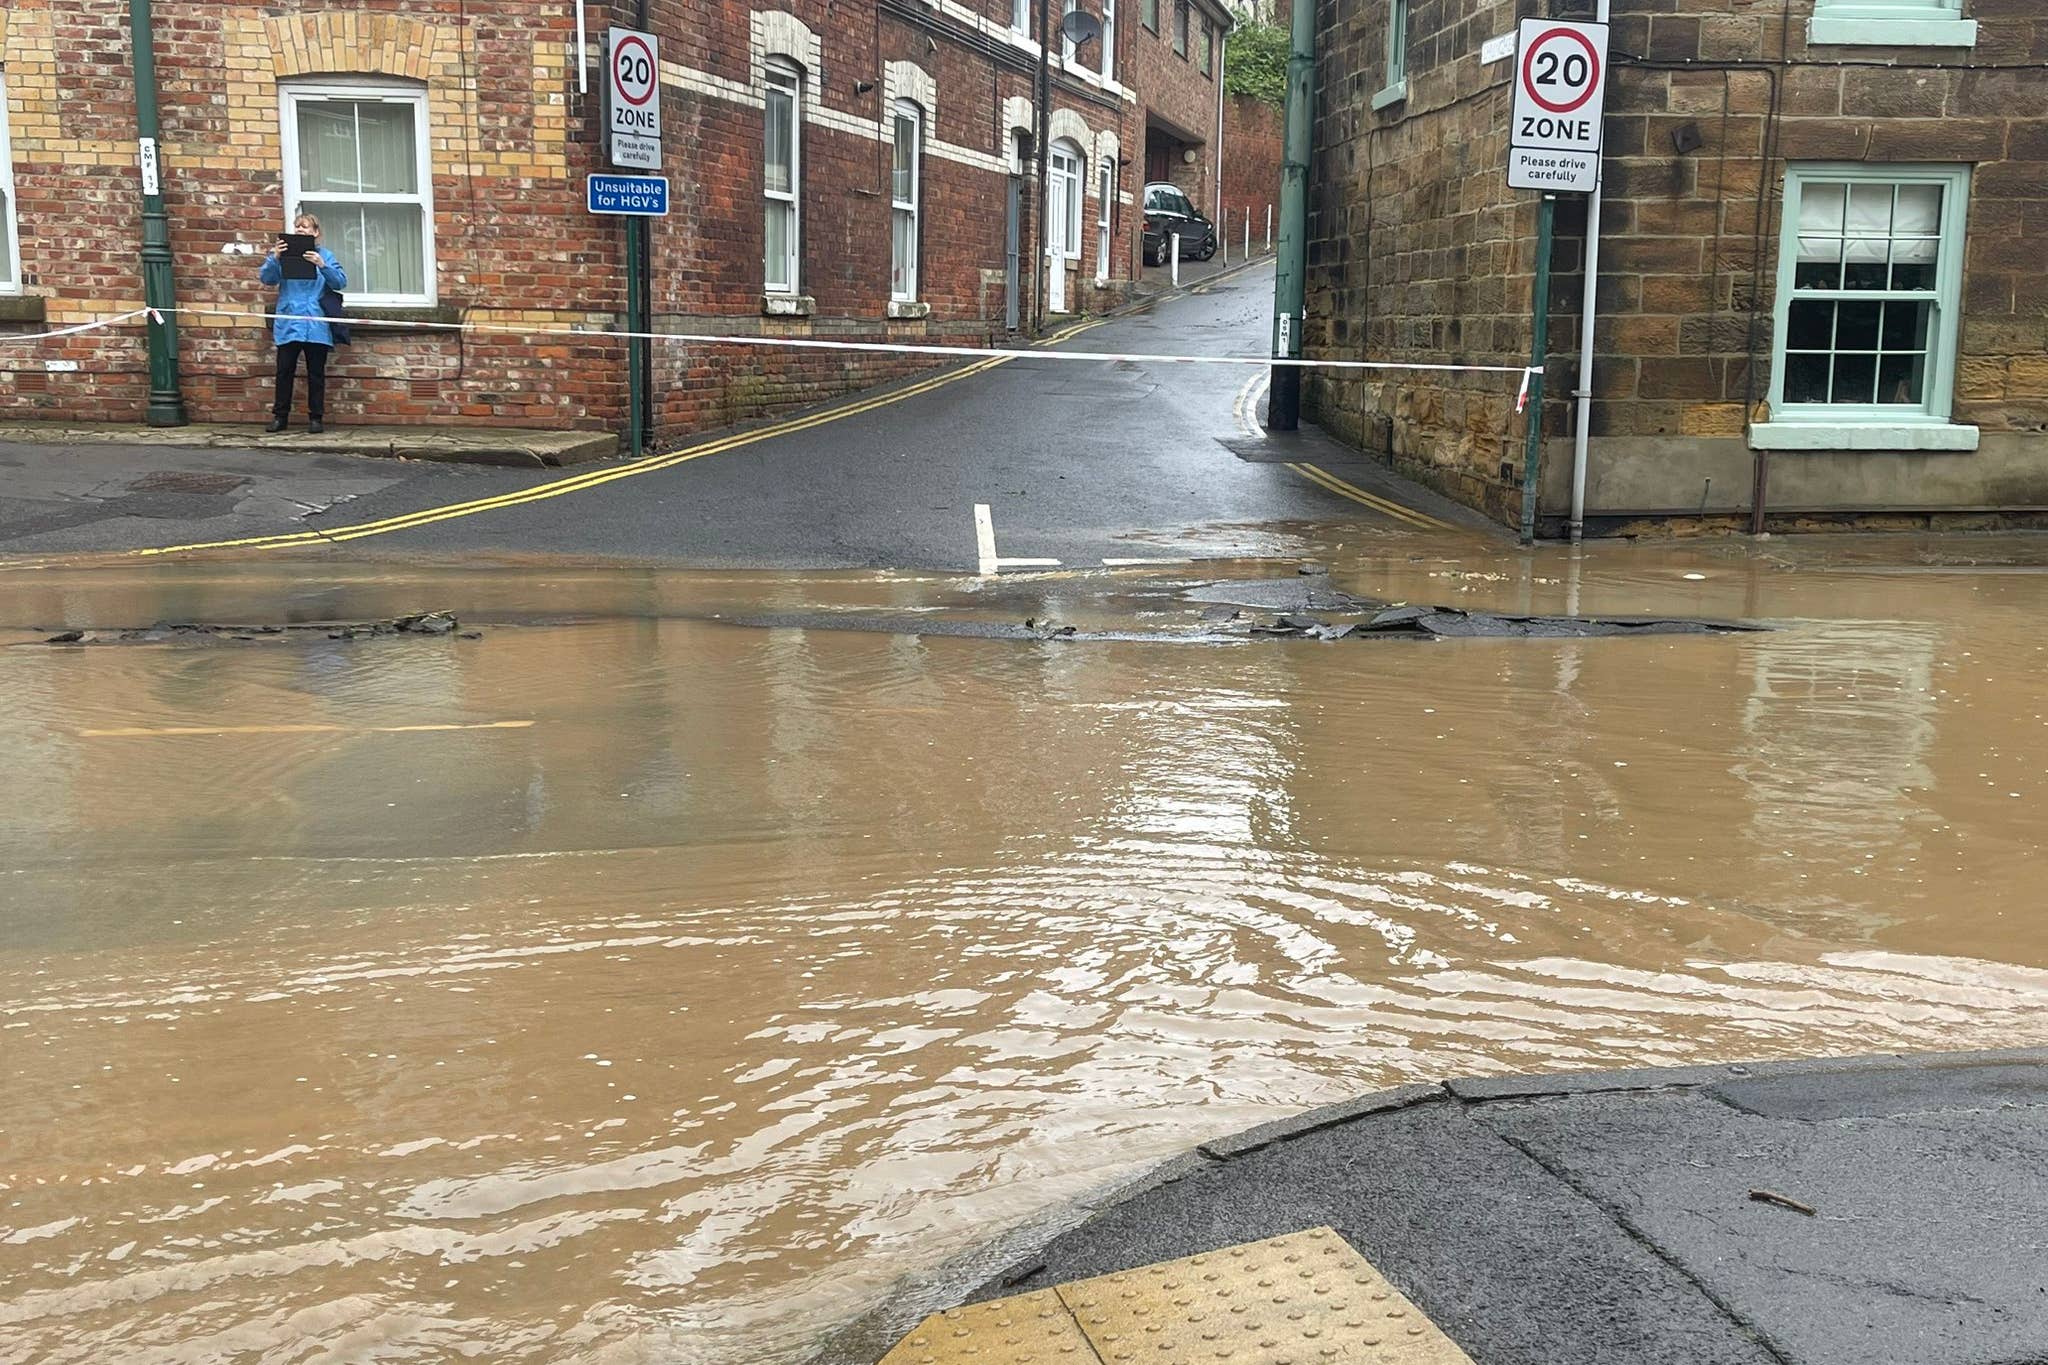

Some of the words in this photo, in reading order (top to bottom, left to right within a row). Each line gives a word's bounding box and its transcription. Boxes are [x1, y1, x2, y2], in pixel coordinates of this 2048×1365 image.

[621, 55, 650, 85] 20
[1536, 52, 1588, 87] 20
[616, 108, 656, 128] ZONE
[1521, 117, 1591, 140] ZONE
[617, 139, 638, 150] Please
[640, 142, 655, 152] drive
[623, 152, 650, 162] carefully
[1520, 155, 1557, 168] Please
[1559, 157, 1587, 170] drive
[1528, 169, 1577, 183] carefully
[594, 180, 662, 195] Unsuitable
[598, 194, 616, 207] for
[621, 195, 659, 208] HGV's
